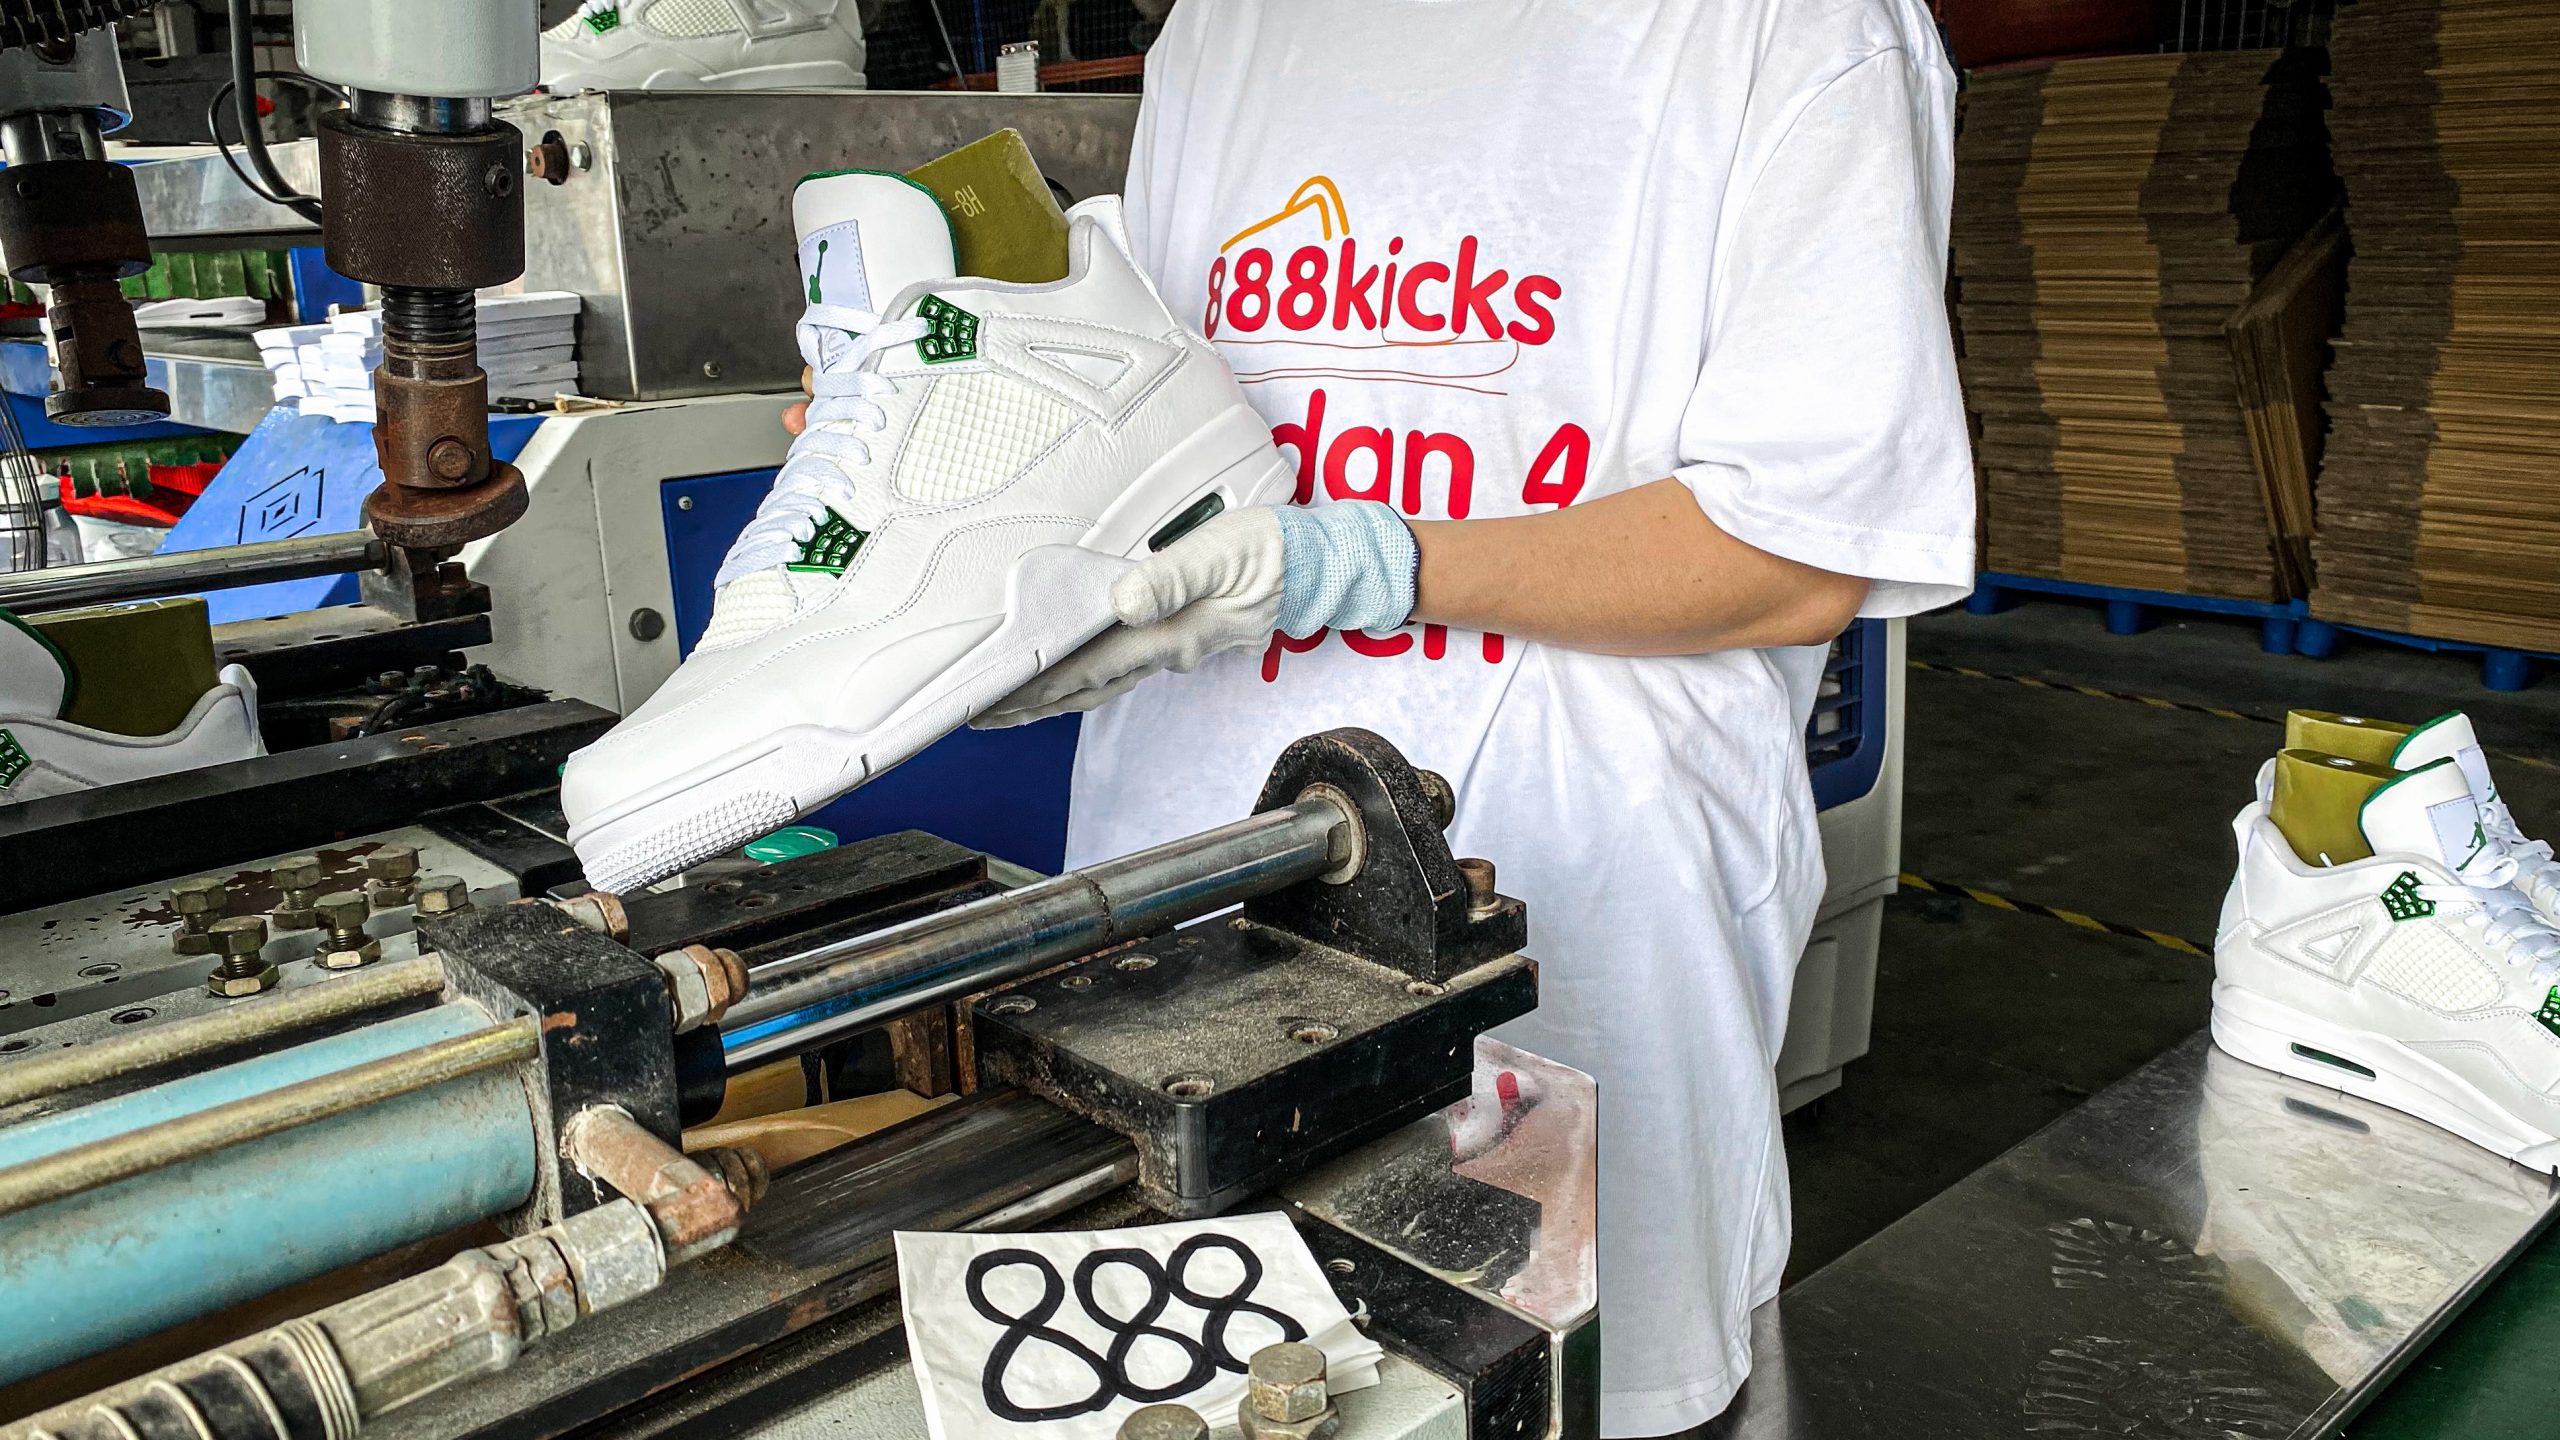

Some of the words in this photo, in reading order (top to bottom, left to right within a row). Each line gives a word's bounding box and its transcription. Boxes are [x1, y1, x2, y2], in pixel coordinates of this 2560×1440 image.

[1203, 235, 1562, 346] 888kicks
[1521, 422, 1591, 511] 4
[965, 1232, 1308, 1422] 888
